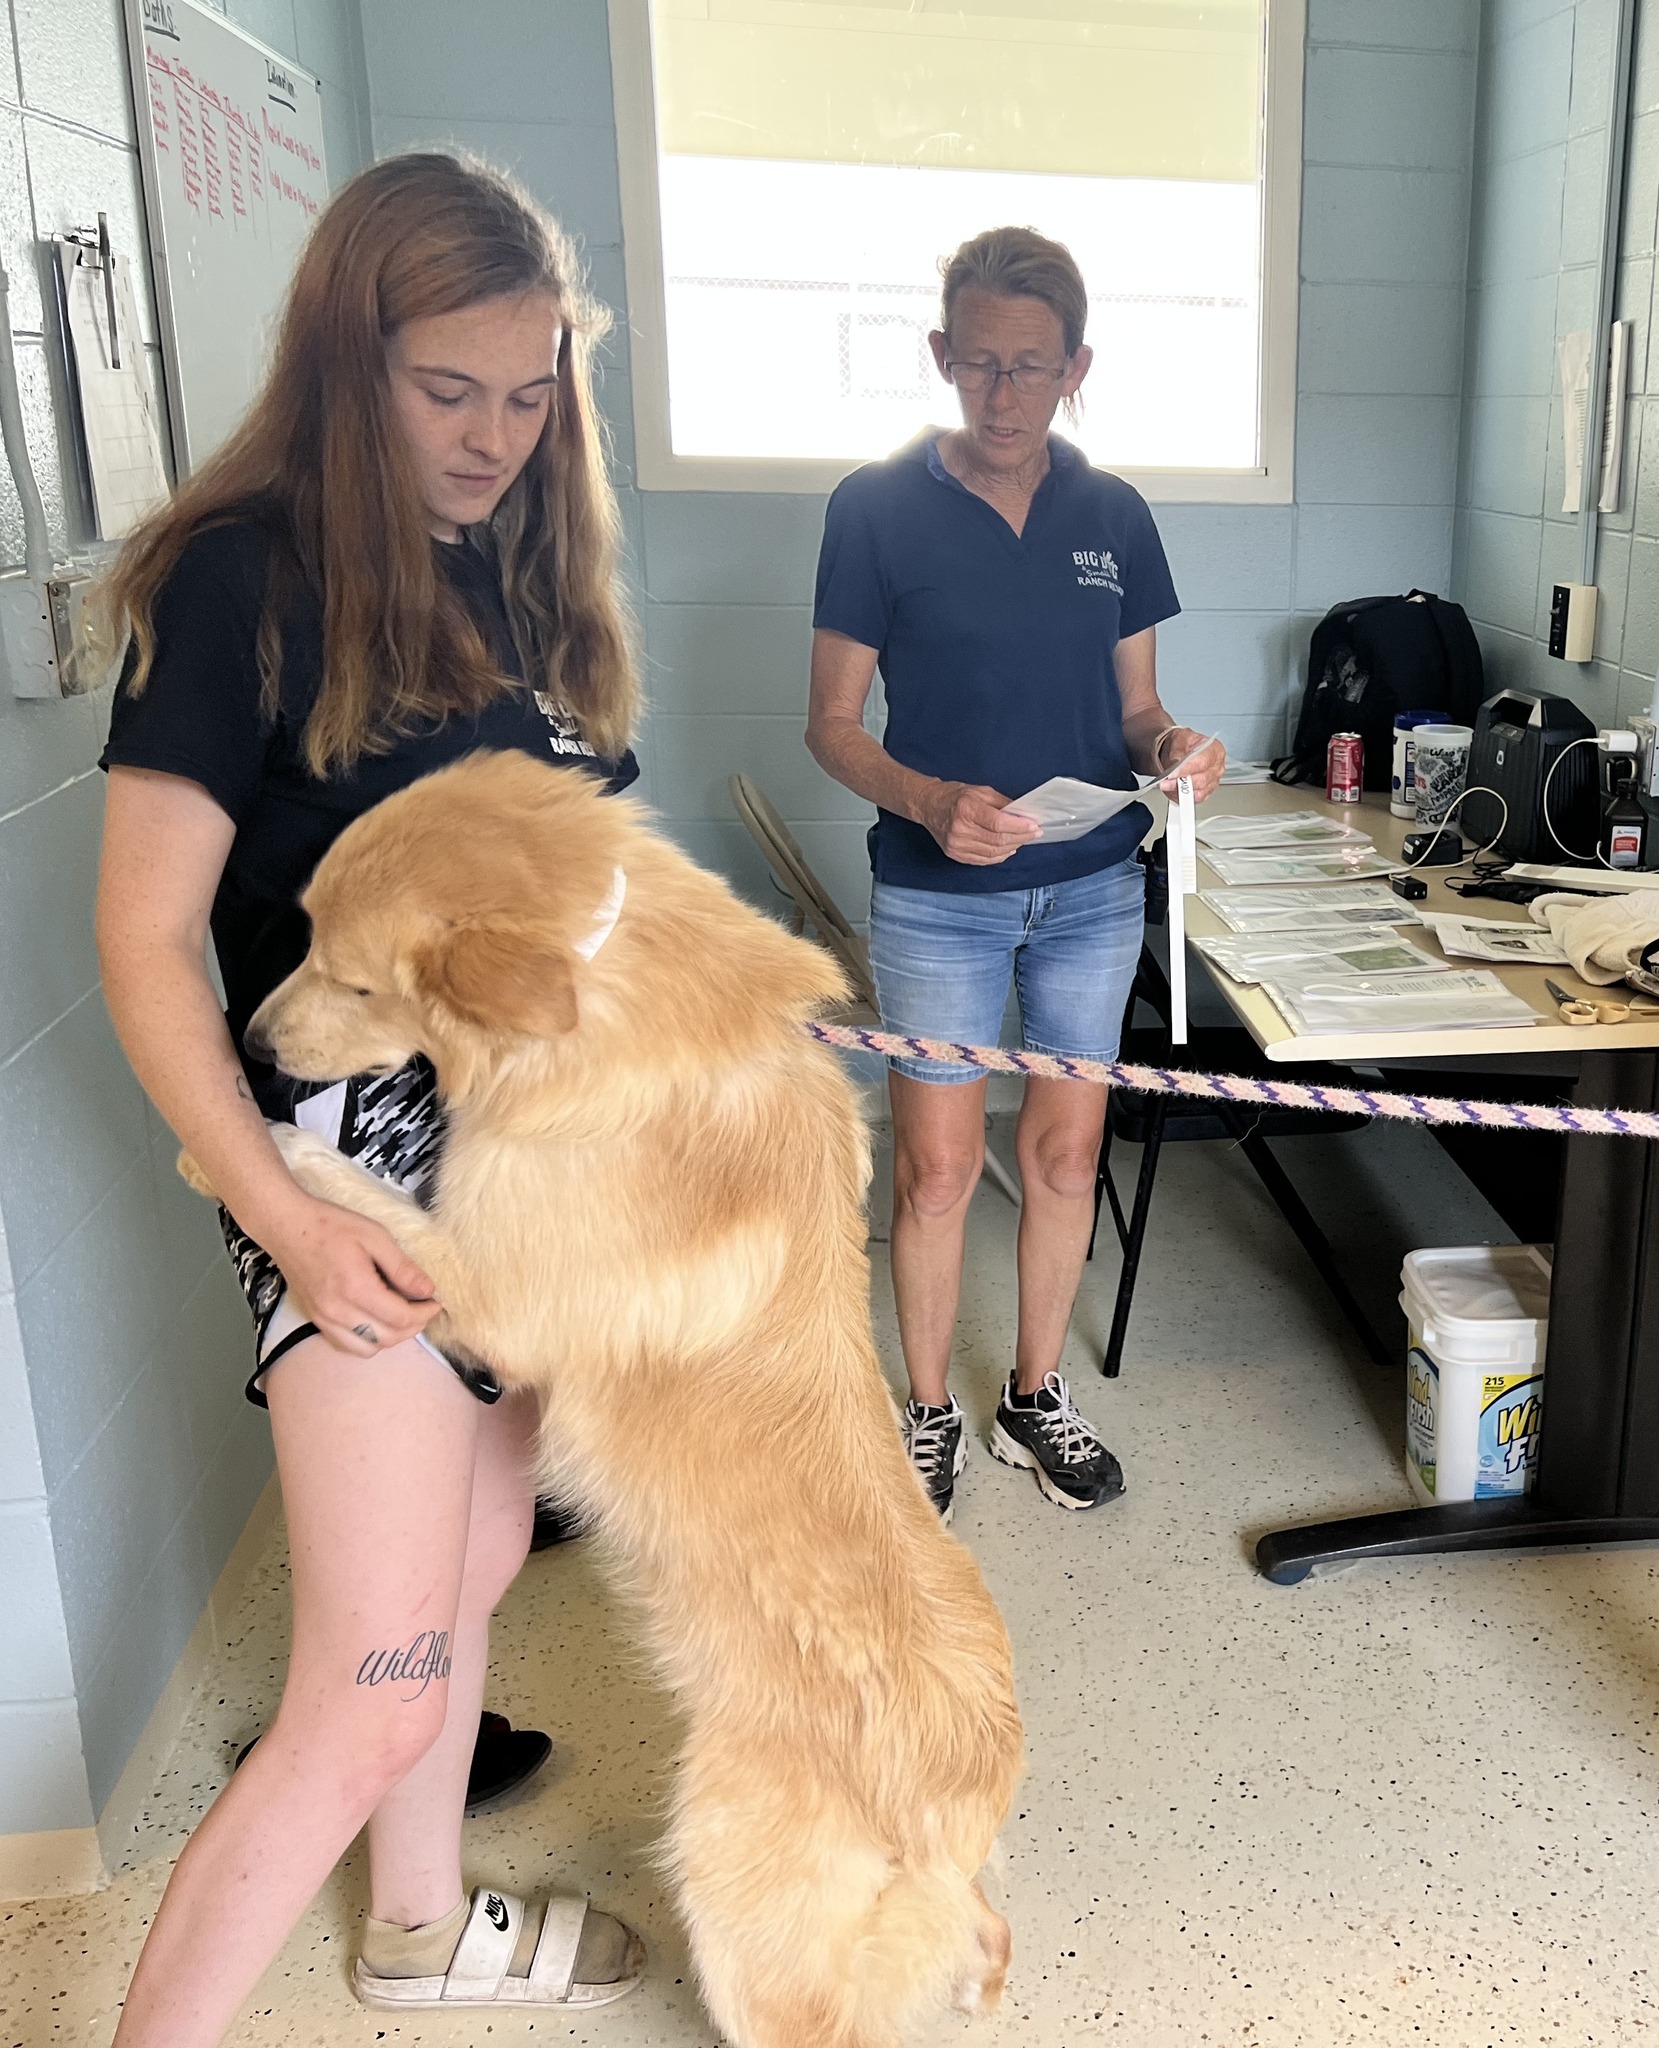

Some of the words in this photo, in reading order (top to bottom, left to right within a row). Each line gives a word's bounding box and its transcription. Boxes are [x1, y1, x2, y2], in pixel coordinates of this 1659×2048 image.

[1072, 551, 1099, 567] BIG
[1077, 576, 1108, 588] RANCH
[1485, 1377, 1504, 1386] 215
[1497, 1394, 1542, 1447] Wi
[484, 1893, 503, 1921] NIKE
